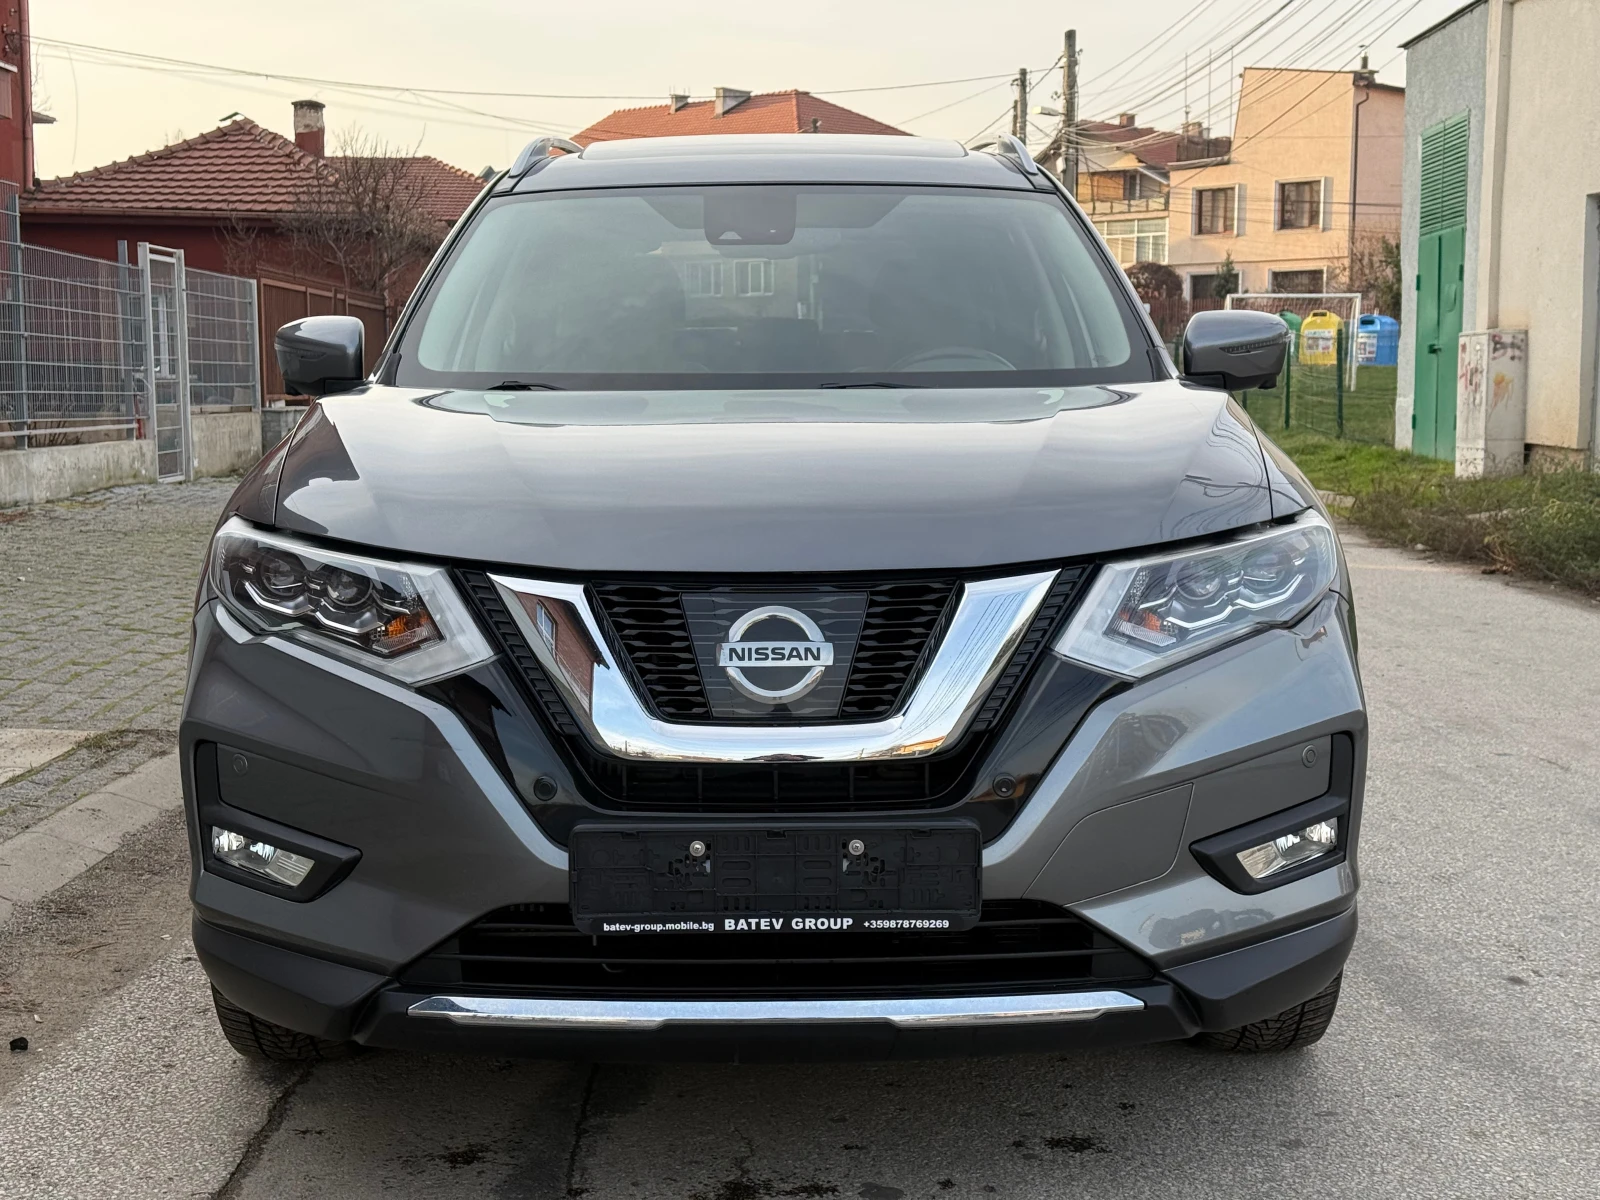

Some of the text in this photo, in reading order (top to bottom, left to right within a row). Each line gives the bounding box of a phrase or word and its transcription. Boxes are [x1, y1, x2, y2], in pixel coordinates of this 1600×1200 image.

[728, 647, 820, 661] NISSAN
[603, 918, 949, 932] batev-group.mobile.bg BATEV GROUP +359878769269
